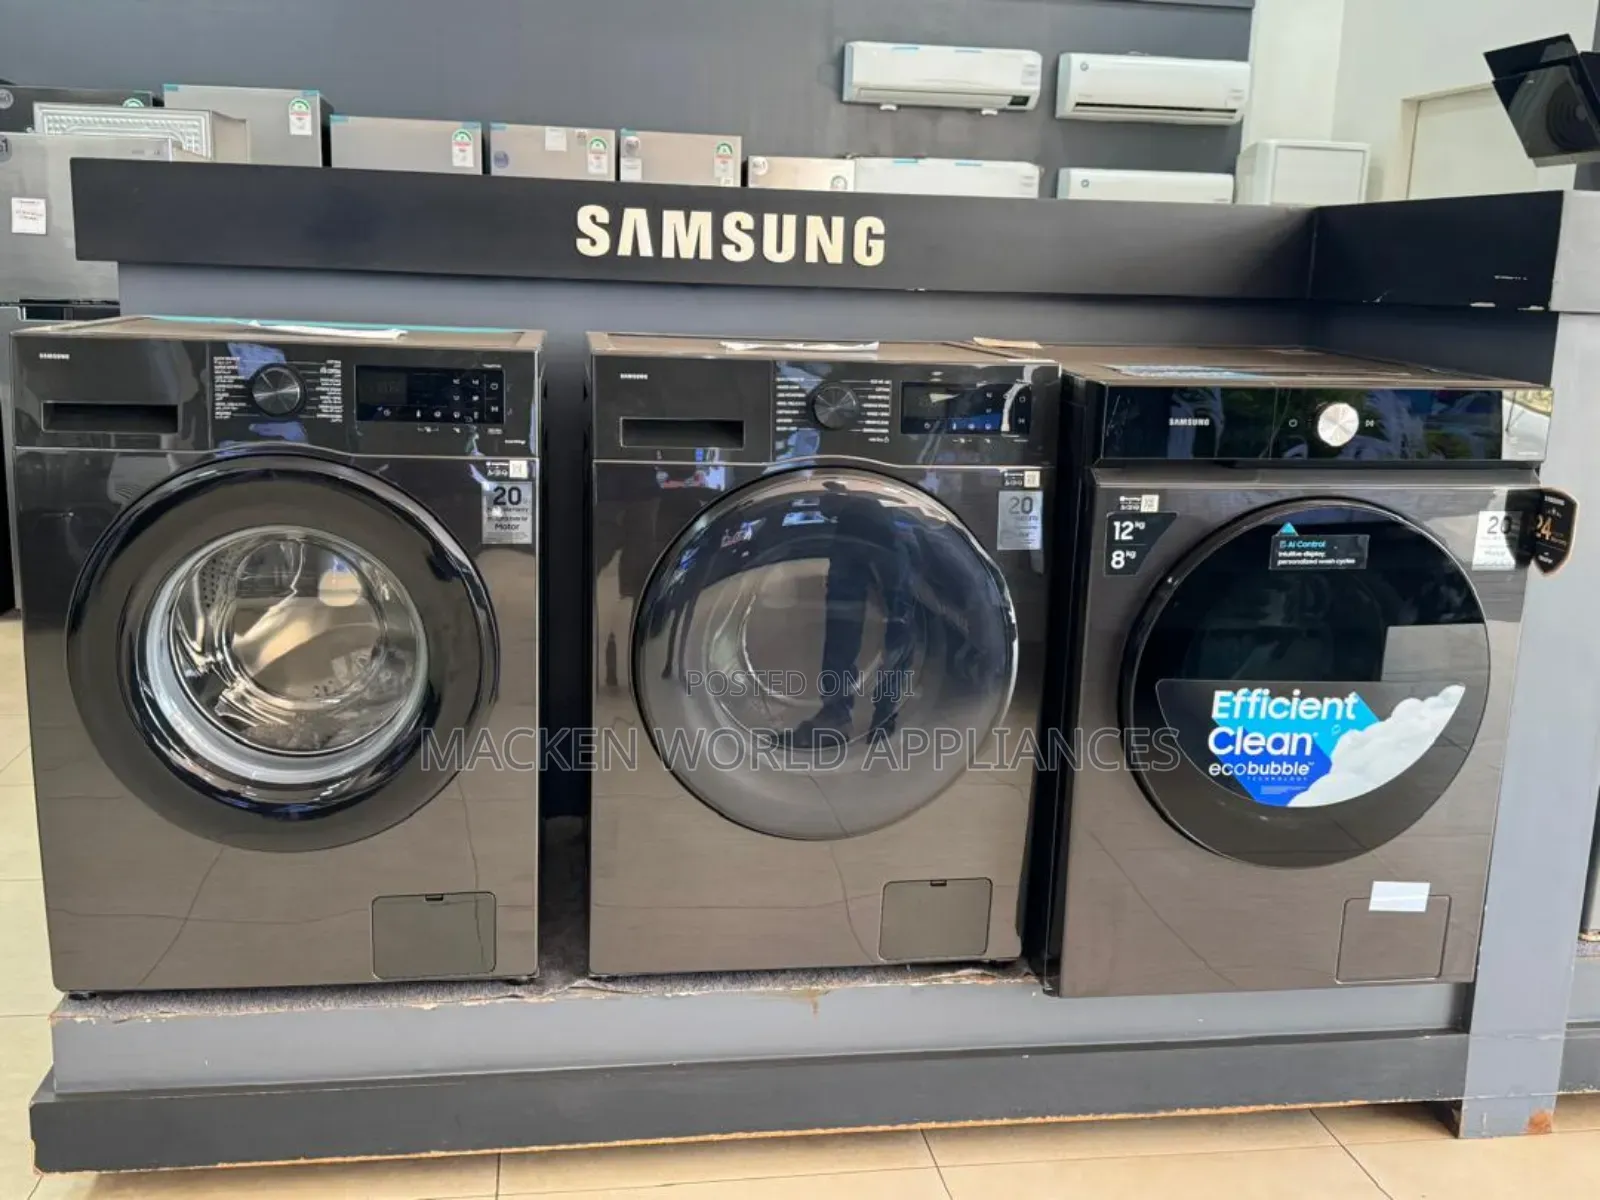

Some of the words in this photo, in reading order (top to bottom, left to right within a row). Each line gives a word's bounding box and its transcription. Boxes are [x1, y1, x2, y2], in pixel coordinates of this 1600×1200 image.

[575, 204, 886, 266] SAMSUNG
[1168, 417, 1210, 426] SAMSUNG
[493, 486, 522, 505] 20
[1009, 496, 1033, 514] 20
[494, 523, 520, 531] Motor
[1487, 515, 1512, 534] 20
[1211, 687, 1358, 720] Efficient
[1208, 725, 1312, 756] Clean
